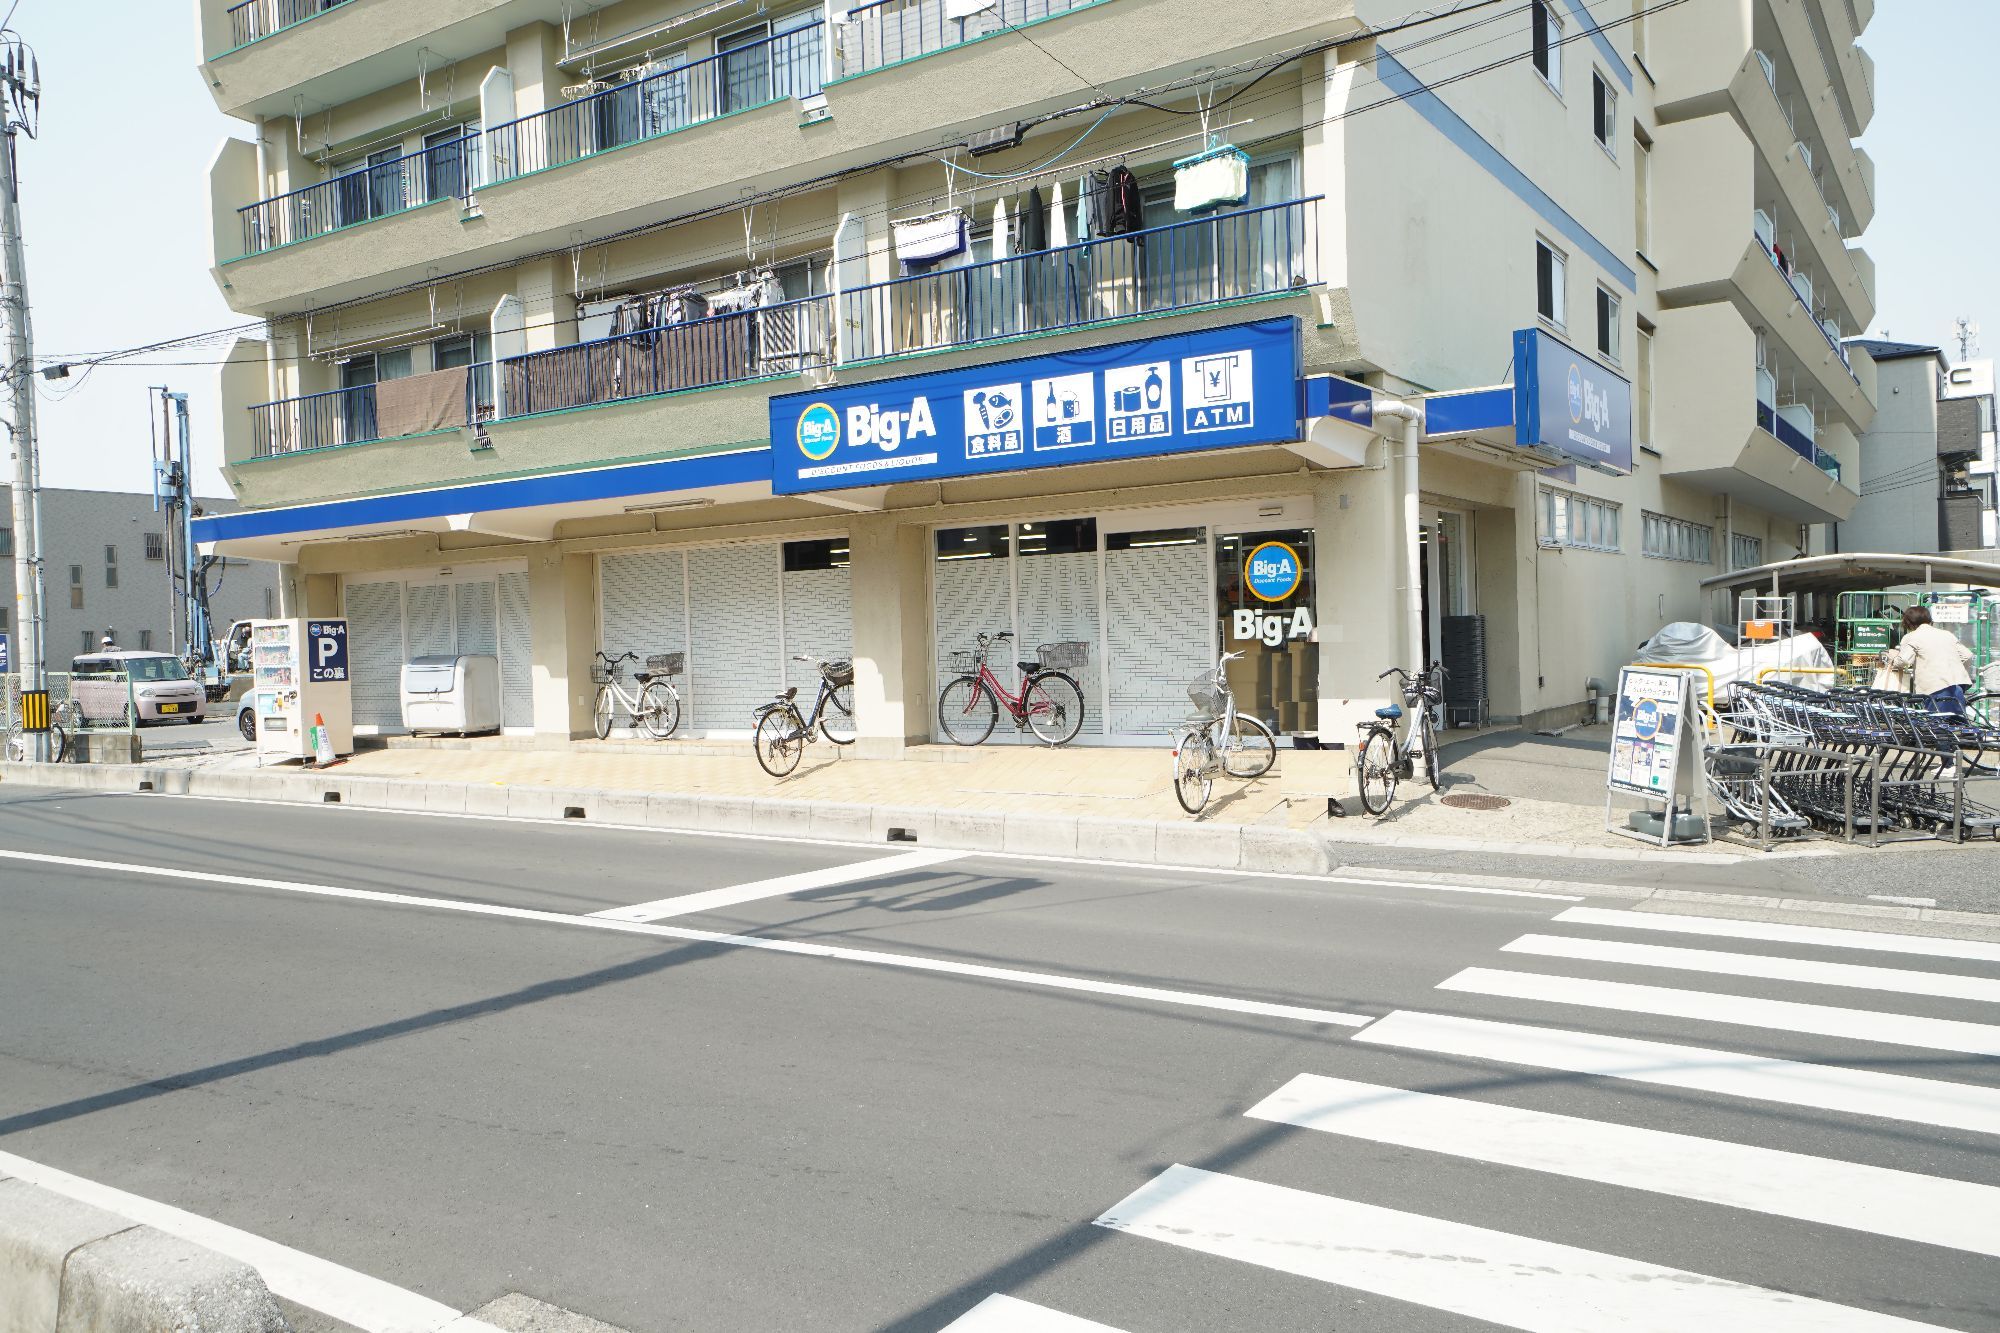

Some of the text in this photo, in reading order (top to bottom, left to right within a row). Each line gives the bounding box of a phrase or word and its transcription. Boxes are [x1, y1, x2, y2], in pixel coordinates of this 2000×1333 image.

[846, 396, 937, 452] Big-A
[1112, 414, 1165, 437] 日用品
[1194, 405, 1243, 427] ATM
[971, 432, 1018, 453] 食料品
[1056, 425, 1072, 443] 酒
[1253, 558, 1292, 578] Big-A
[1233, 606, 1313, 647] Big-A
[318, 638, 338, 666] P
[313, 667, 345, 679] この裏
